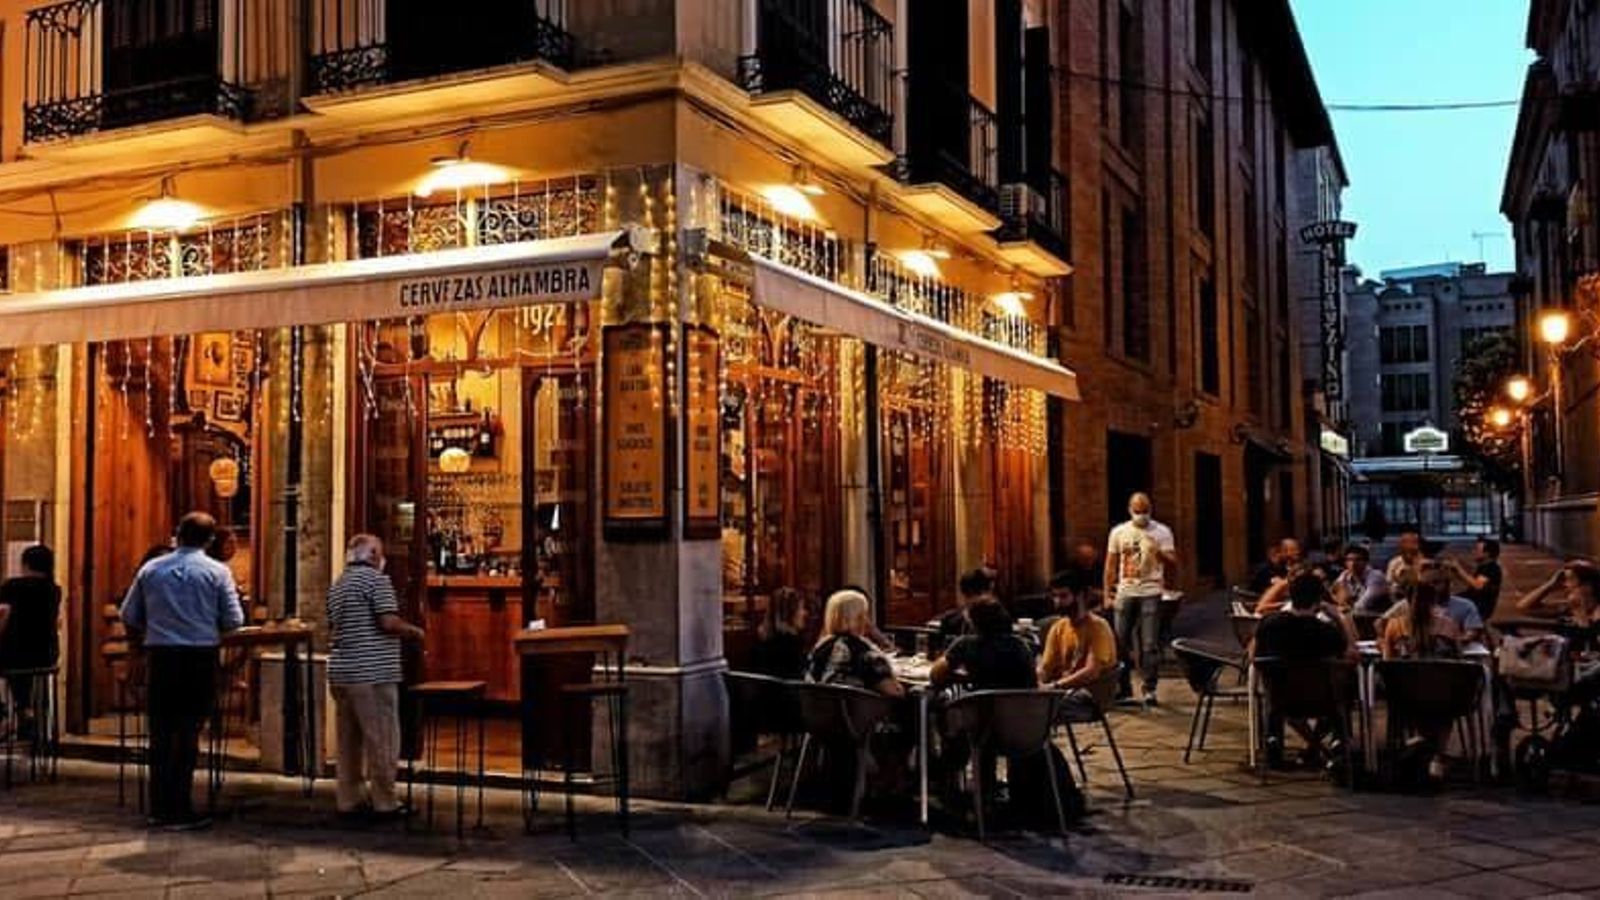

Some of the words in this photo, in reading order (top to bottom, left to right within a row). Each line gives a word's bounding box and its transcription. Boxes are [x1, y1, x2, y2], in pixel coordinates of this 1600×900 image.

[1303, 222, 1352, 240] HOTEL
[400, 276, 483, 307] CERVEZAS
[487, 266, 590, 298] ALHAMBRA
